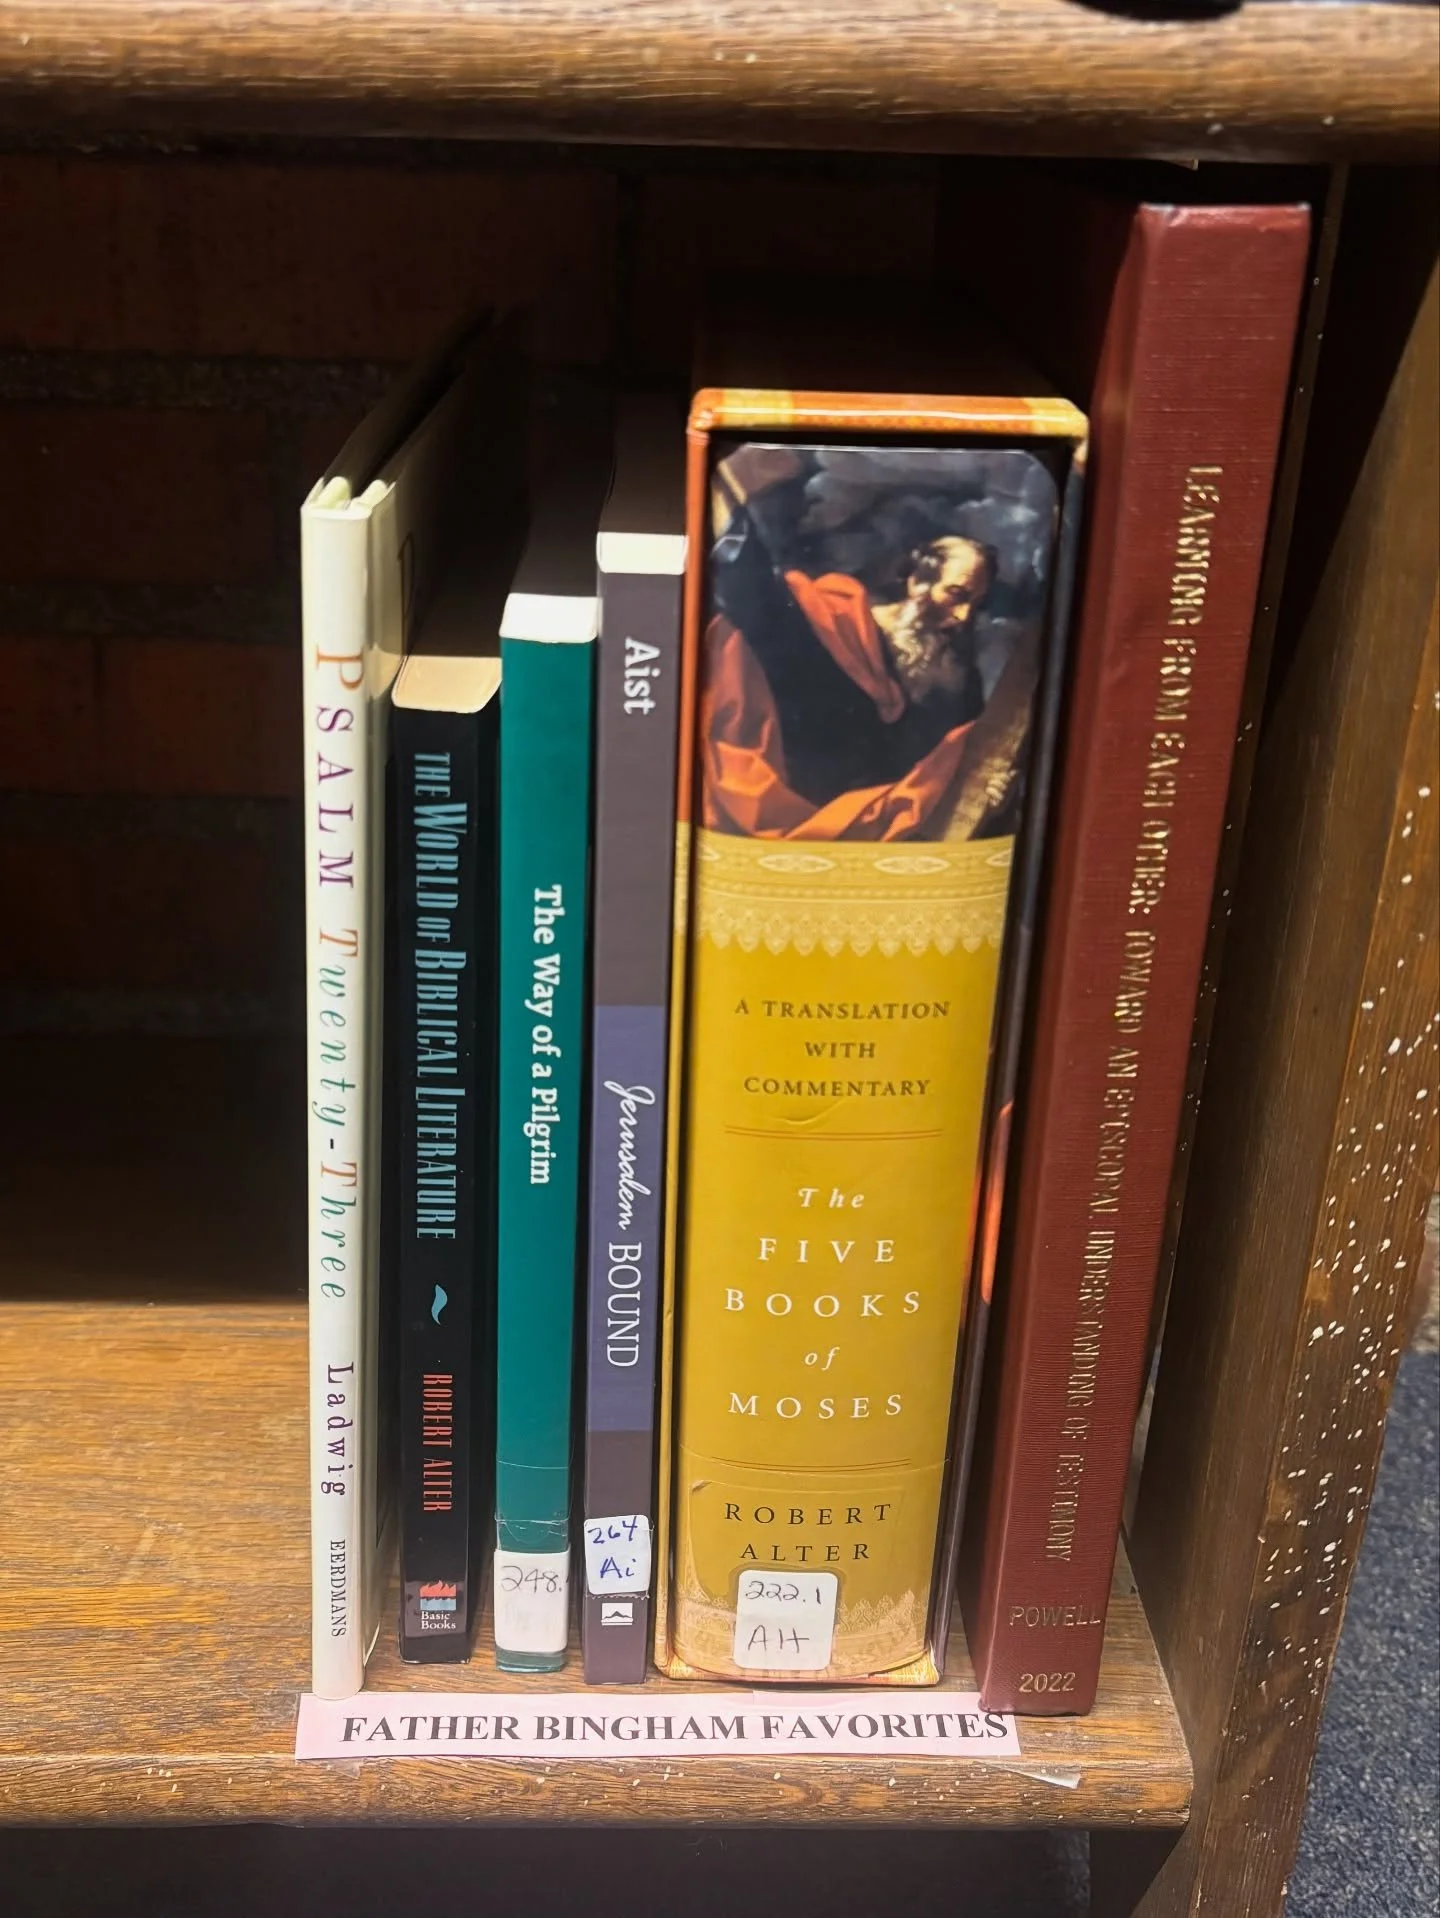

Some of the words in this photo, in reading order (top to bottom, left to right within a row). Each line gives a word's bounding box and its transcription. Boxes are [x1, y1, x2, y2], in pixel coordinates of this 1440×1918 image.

[1168, 467, 1223, 625] LEARNING
[624, 636, 661, 715] Aist
[1153, 638, 1197, 721] FROM
[315, 645, 365, 888] PSALM
[414, 752, 451, 798] THE
[1141, 733, 1187, 807] EACH
[414, 802, 468, 909] WORLD
[1129, 820, 1171, 914] OTHER:
[416, 915, 451, 943] OF
[533, 884, 565, 945] The
[525, 953, 561, 1017] Way
[1115, 930, 1156, 1034] TOWARD
[415, 949, 467, 1078] BIBLICAL
[735, 997, 749, 1014] A
[762, 999, 951, 1019] TRANSLATION
[531, 1024, 562, 1058] of
[804, 1041, 876, 1058] WITH
[1107, 1046, 1140, 1078] AN
[531, 1063, 553, 1079] a
[743, 1076, 930, 1096] COMMENTARY
[311, 928, 358, 1298] Twenty-Three
[523, 1087, 561, 1185] Pilgrim
[415, 1086, 466, 1239] LITERATURE
[604, 1080, 656, 1231] Jerusalem
[1088, 1088, 1135, 1219] EPISCOPAL
[798, 1187, 865, 1208] The
[757, 1237, 896, 1263] FIVE
[606, 1241, 643, 1369] BOUND
[723, 1287, 919, 1318] BOOKS
[1066, 1230, 1116, 1408] UNDERSTANDING
[804, 1346, 841, 1370] of
[320, 1361, 355, 1496] Ladwig
[422, 1373, 453, 1448] ROBERT
[728, 1391, 902, 1420] MOSES
[1060, 1416, 1091, 1440] OF
[422, 1457, 453, 1512] ALTER
[1045, 1454, 1084, 1561] TESTIMONY
[587, 1515, 638, 1545] 264
[723, 1502, 891, 1526] ROBERT
[600, 1556, 637, 1578] Ai
[740, 1542, 871, 1562] ALTER
[329, 1539, 347, 1638] EERDMANS
[420, 1611, 450, 1621] Basic
[421, 1620, 457, 1630] Books
[1009, 1605, 1101, 1627] POWELL
[1017, 1671, 1076, 1693] 2022
[338, 1714, 521, 1743] FATHER
[533, 1714, 749, 1741] BINGHAM
[760, 1713, 1009, 1740] FAVORITES
